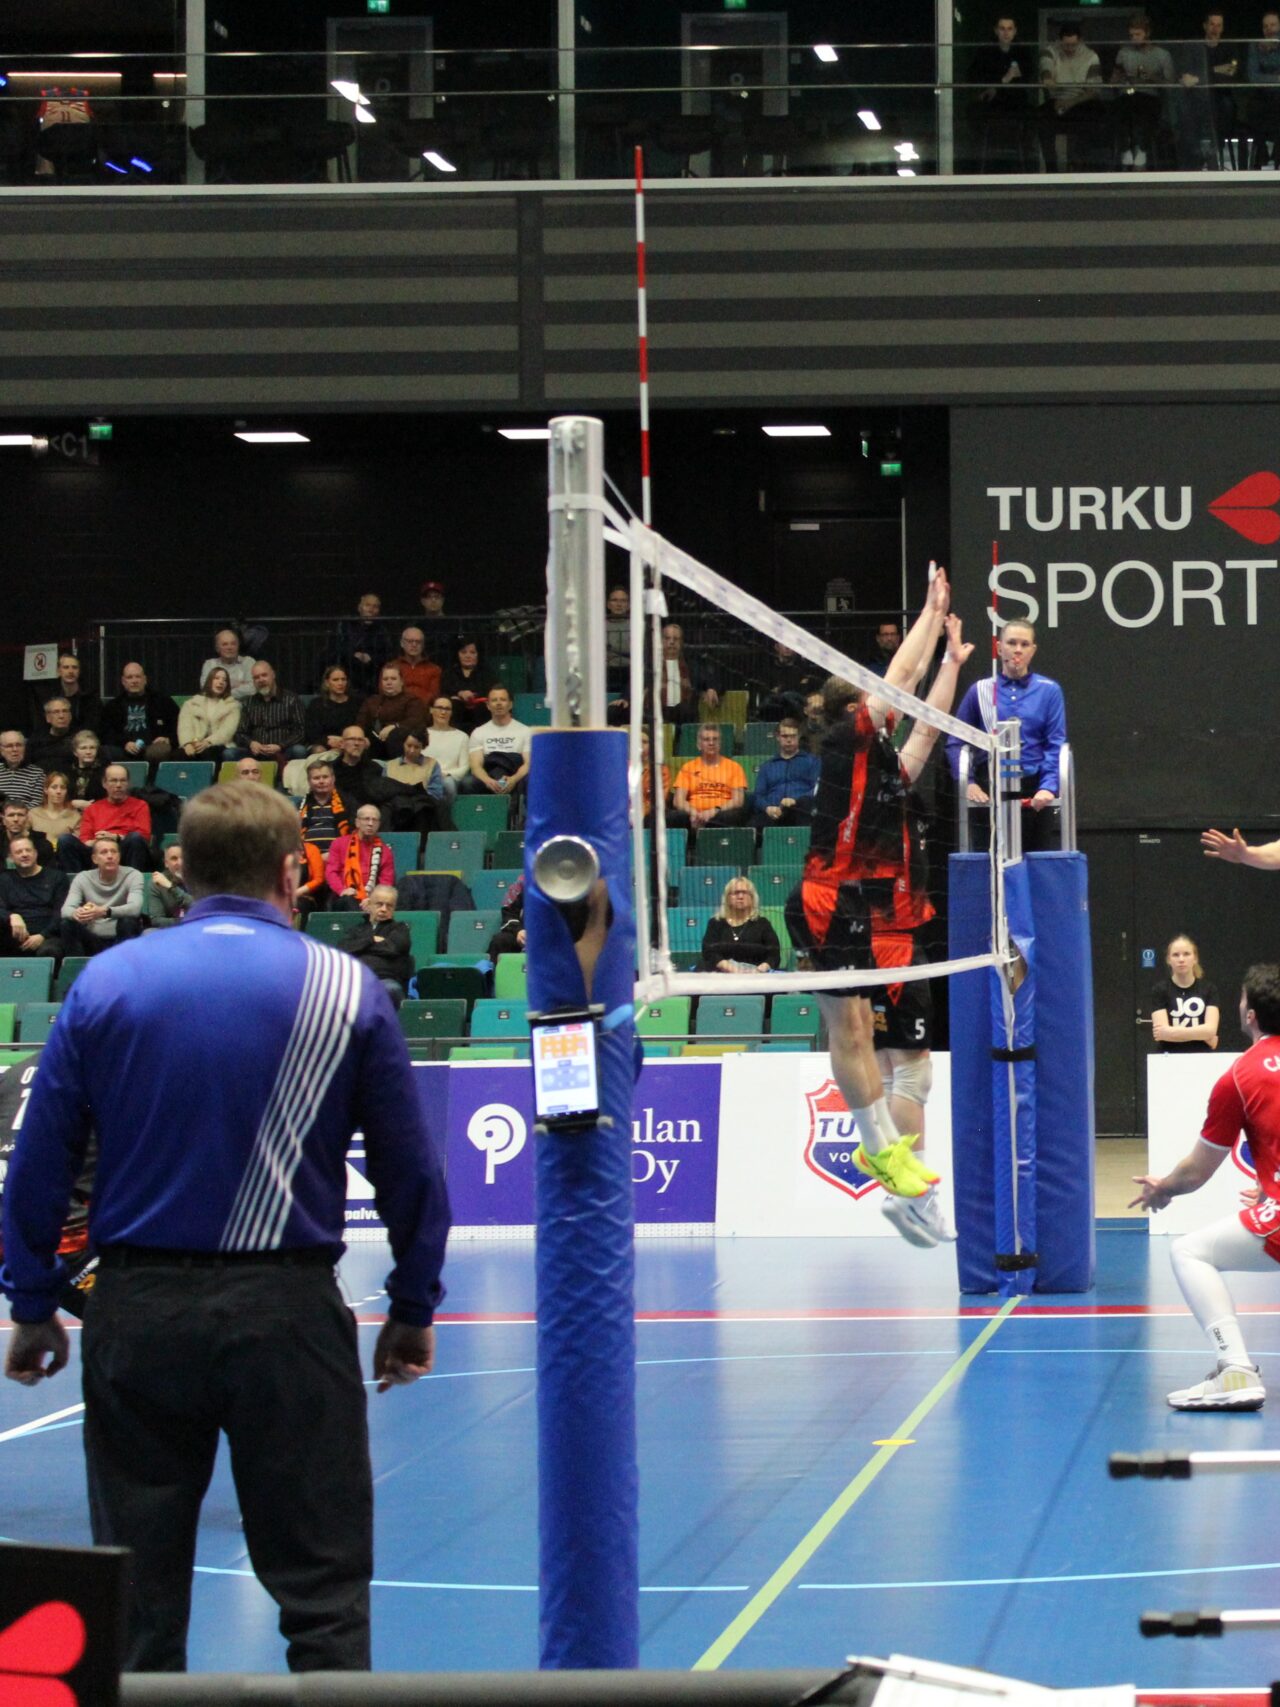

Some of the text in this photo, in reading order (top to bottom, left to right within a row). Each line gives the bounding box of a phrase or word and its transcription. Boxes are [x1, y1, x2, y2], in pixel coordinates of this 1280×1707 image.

[986, 485, 1193, 532] TURKU
[986, 559, 1279, 629] SPORT
[1170, 996, 1206, 1018] JO
[915, 1018, 926, 1040] 5
[819, 1117, 855, 1138] TU
[632, 1149, 680, 1193] Oy
